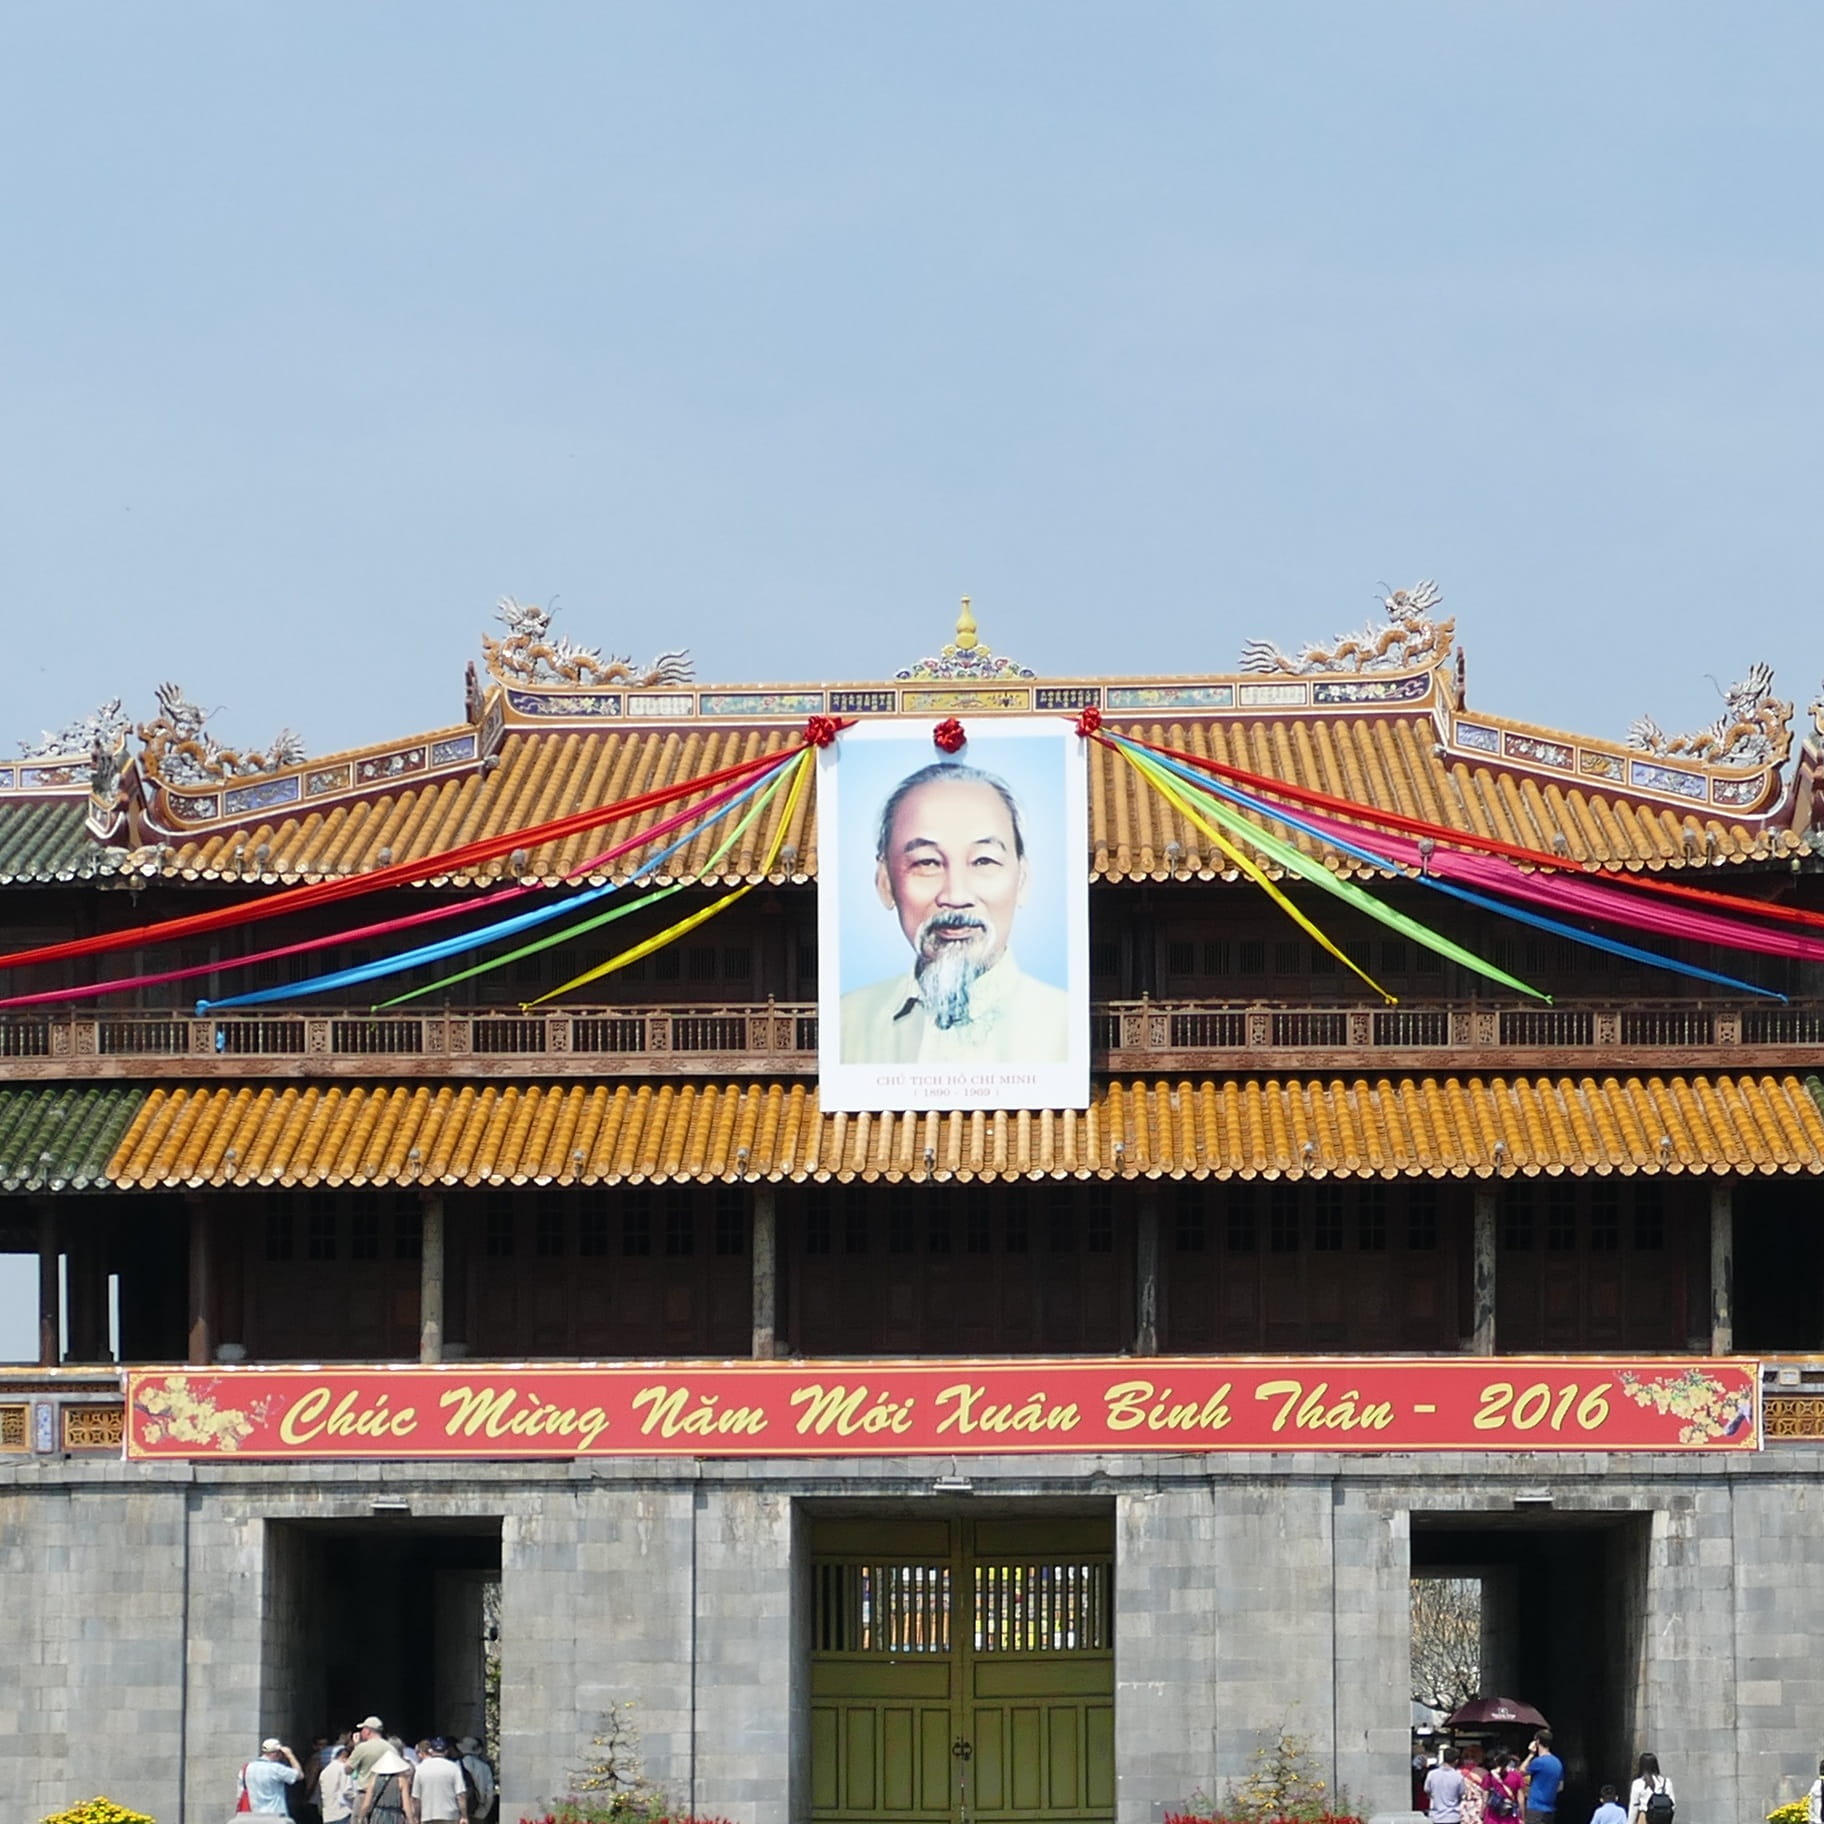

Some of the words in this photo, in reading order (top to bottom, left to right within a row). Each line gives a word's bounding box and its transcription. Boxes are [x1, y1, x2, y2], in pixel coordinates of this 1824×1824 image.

[999, 1074, 1036, 1085] MINH
[279, 1387, 419, 1446] Chúc
[440, 1386, 610, 1451] Mừng
[632, 1385, 770, 1440] Năm
[790, 1384, 916, 1438] Mới
[935, 1383, 1082, 1436] Xuân
[1104, 1381, 1233, 1432] Bính
[1254, 1381, 1395, 1433] Thân
[1413, 1404, 1437, 1414] -
[1473, 1382, 1614, 1432] 2016
